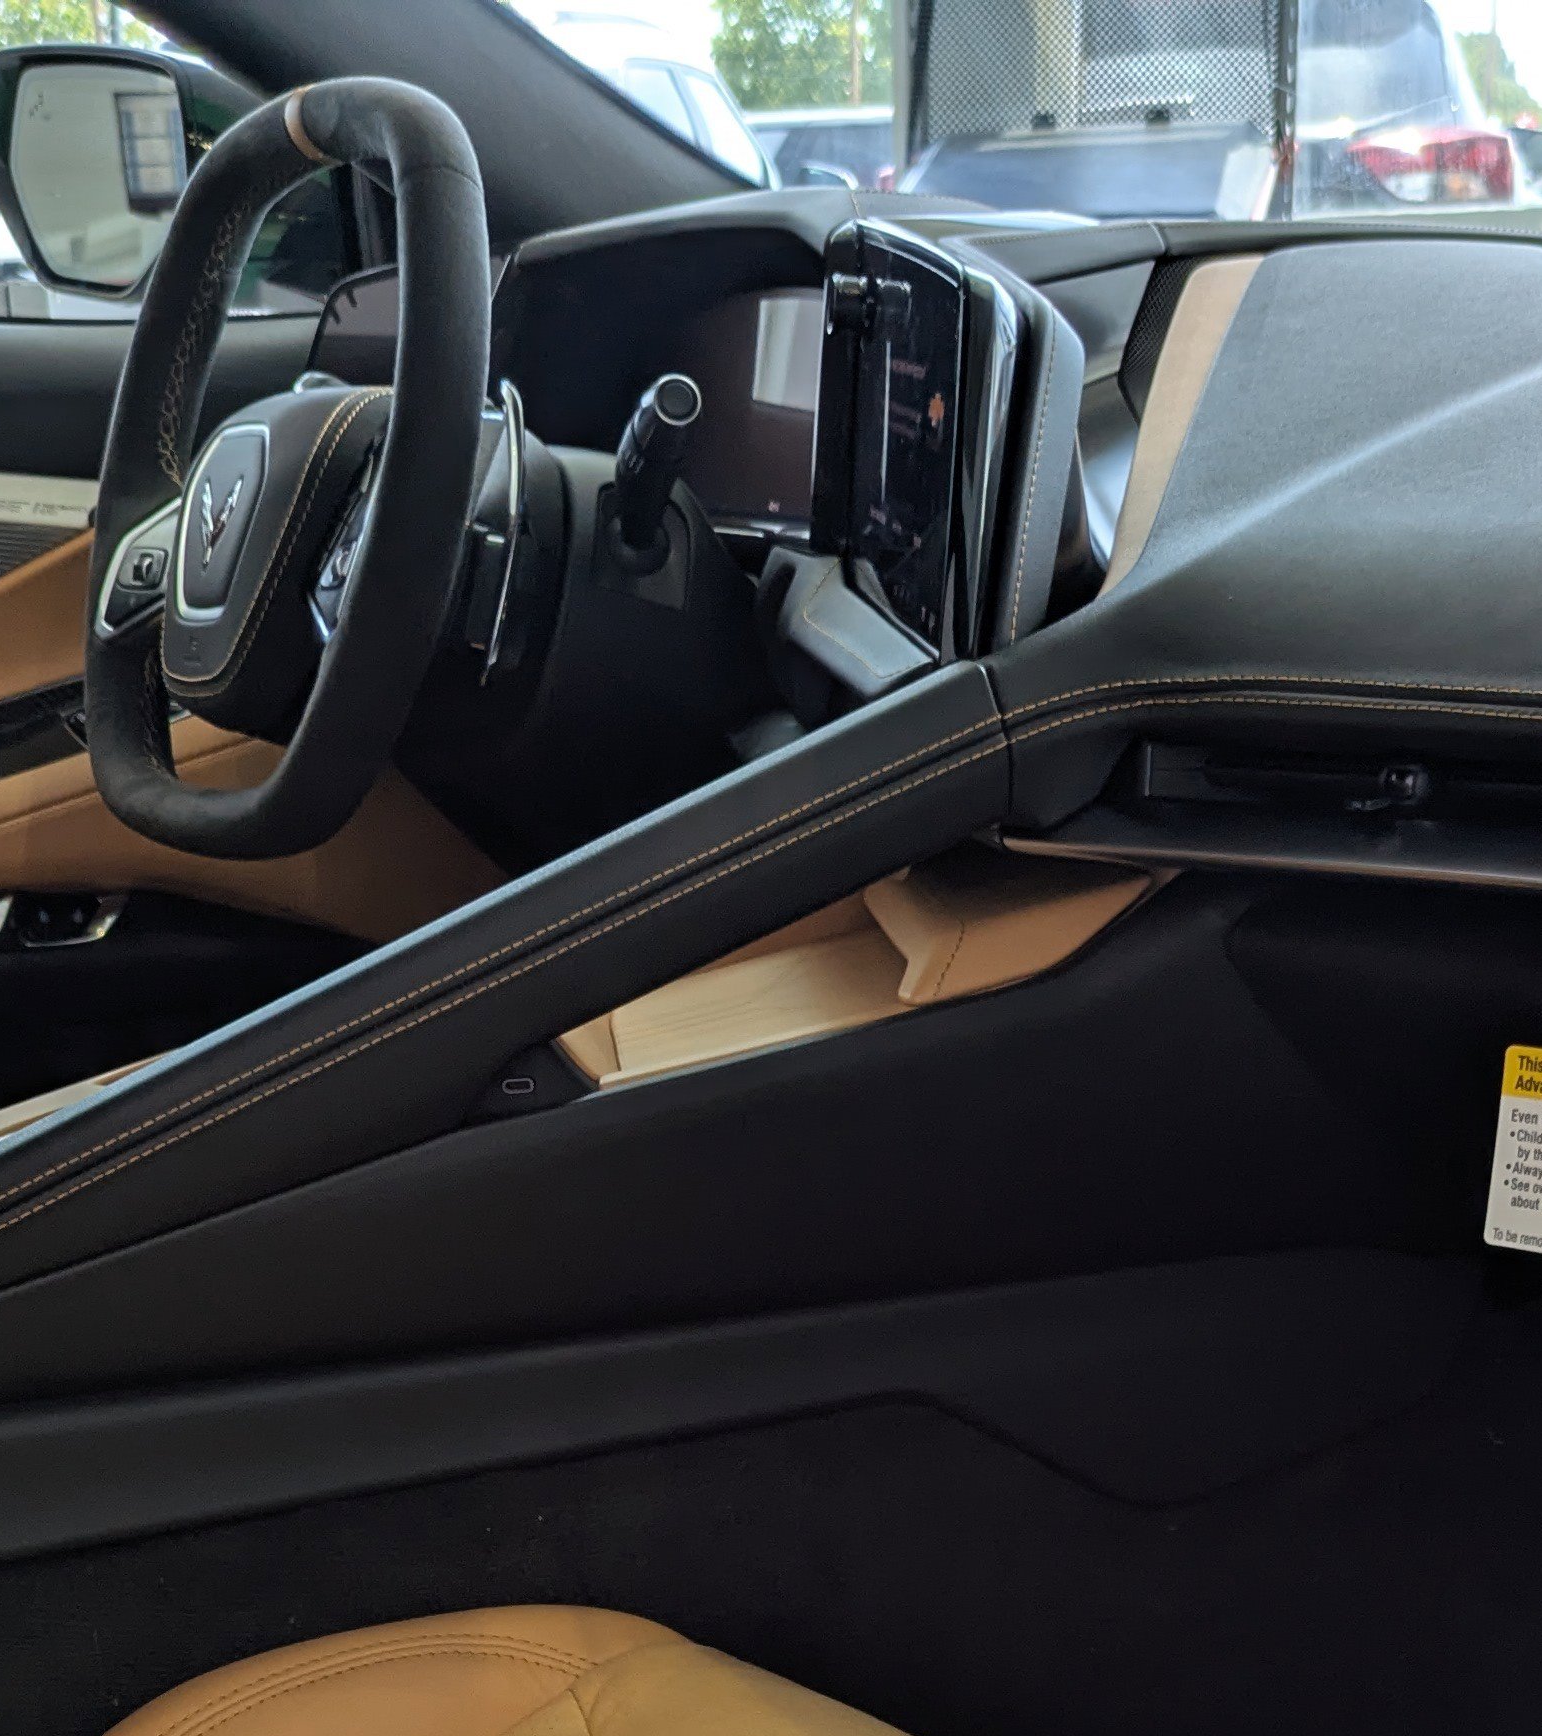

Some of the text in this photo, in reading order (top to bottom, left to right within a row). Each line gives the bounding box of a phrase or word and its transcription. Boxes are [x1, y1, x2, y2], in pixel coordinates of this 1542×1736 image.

[1511, 1108, 1539, 1124] Even
[1517, 1145, 1531, 1161] by
[1510, 1177, 1530, 1192] See
[1510, 1195, 1540, 1211] about
[1493, 1227, 1504, 1241] To
[1505, 1229, 1518, 1243] be
